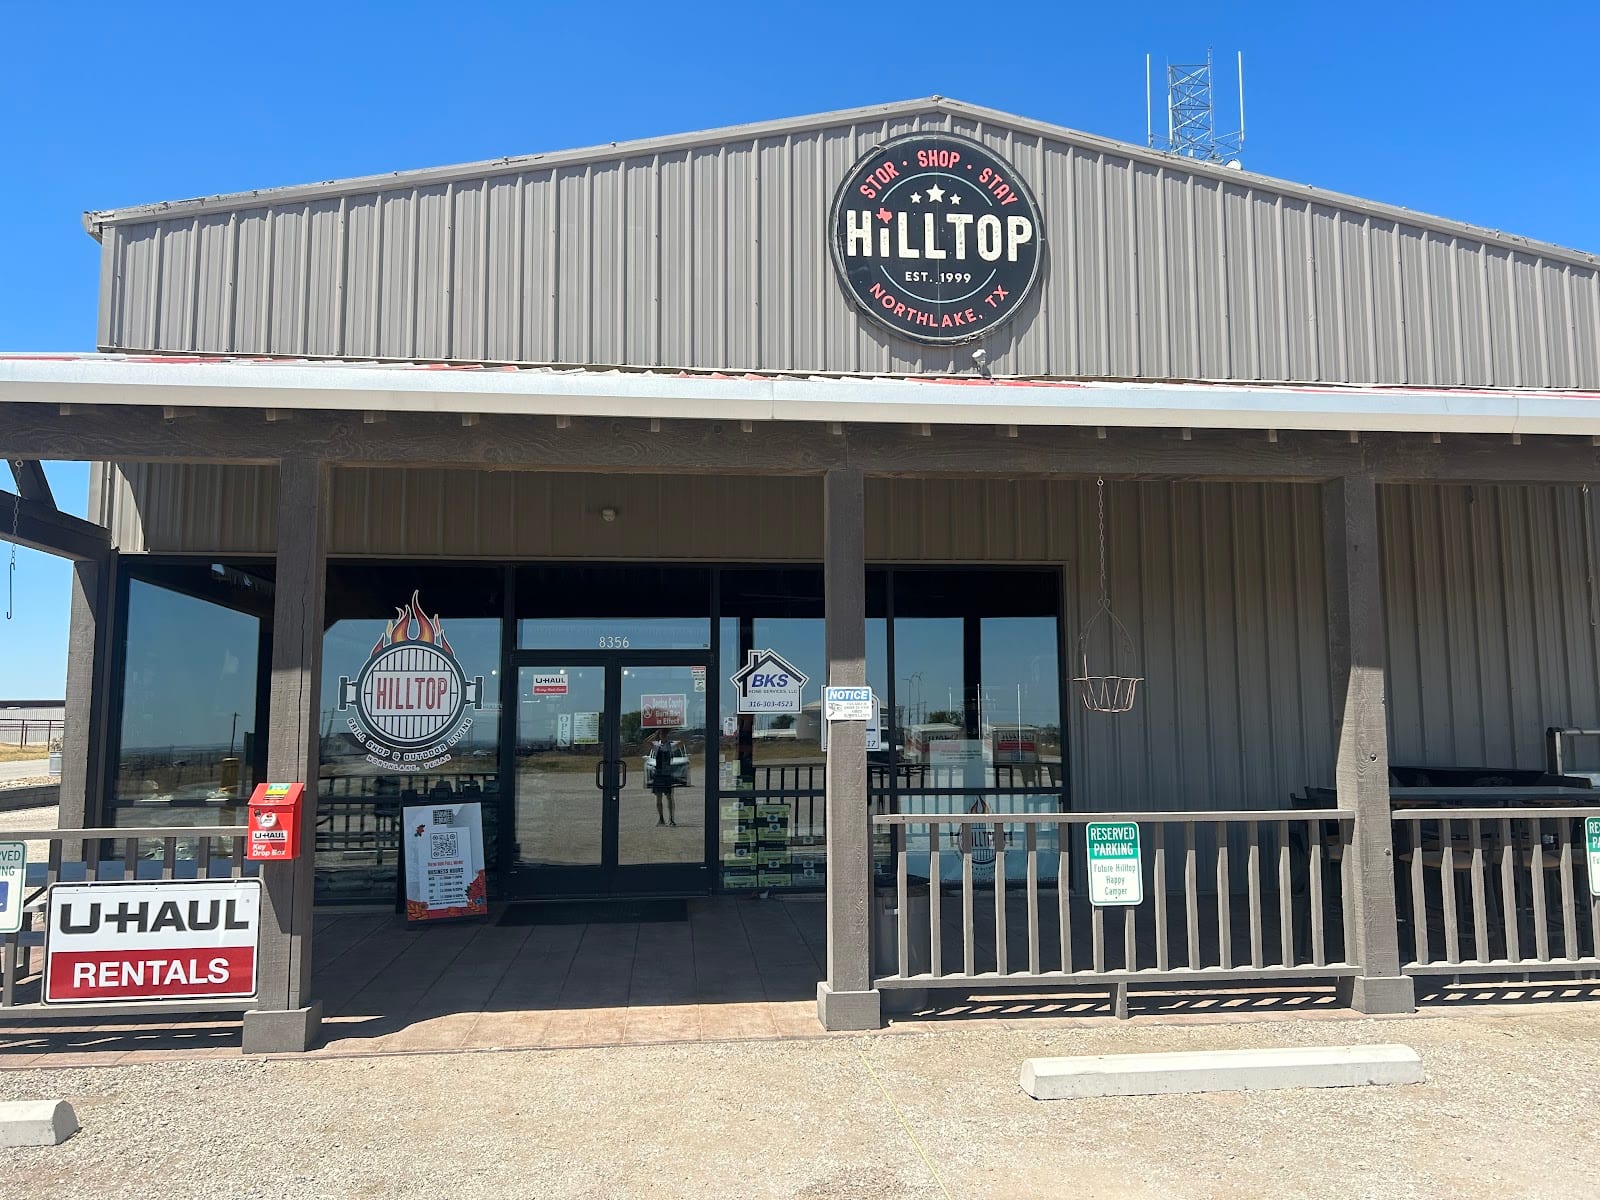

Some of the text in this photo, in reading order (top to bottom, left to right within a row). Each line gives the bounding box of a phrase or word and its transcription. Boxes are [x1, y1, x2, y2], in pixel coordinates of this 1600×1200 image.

[859, 149, 1019, 206] STOR SHOP STAY
[905, 271, 972, 283] EST. 1999
[869, 282, 1009, 328] NORTHLAKE, TX
[599, 636, 630, 649] 8356
[751, 673, 789, 688] BKS
[376, 677, 448, 710] HILLTOP
[829, 690, 869, 700] NOTICE
[347, 717, 473, 761] GRILL SHOP & OUTDOOR LIVING
[424, 753, 452, 769] TEXAS
[1090, 827, 1135, 841] RESERVED
[252, 843, 267, 851] Key
[271, 848, 286, 856] Box
[1093, 842, 1134, 856] PARKING
[1093, 863, 1136, 874] Future Hilltop
[1105, 875, 1125, 886] Happy
[1104, 886, 1127, 896] Camper
[59, 899, 250, 935] U-HAUL
[73, 957, 230, 989] RENTALS
